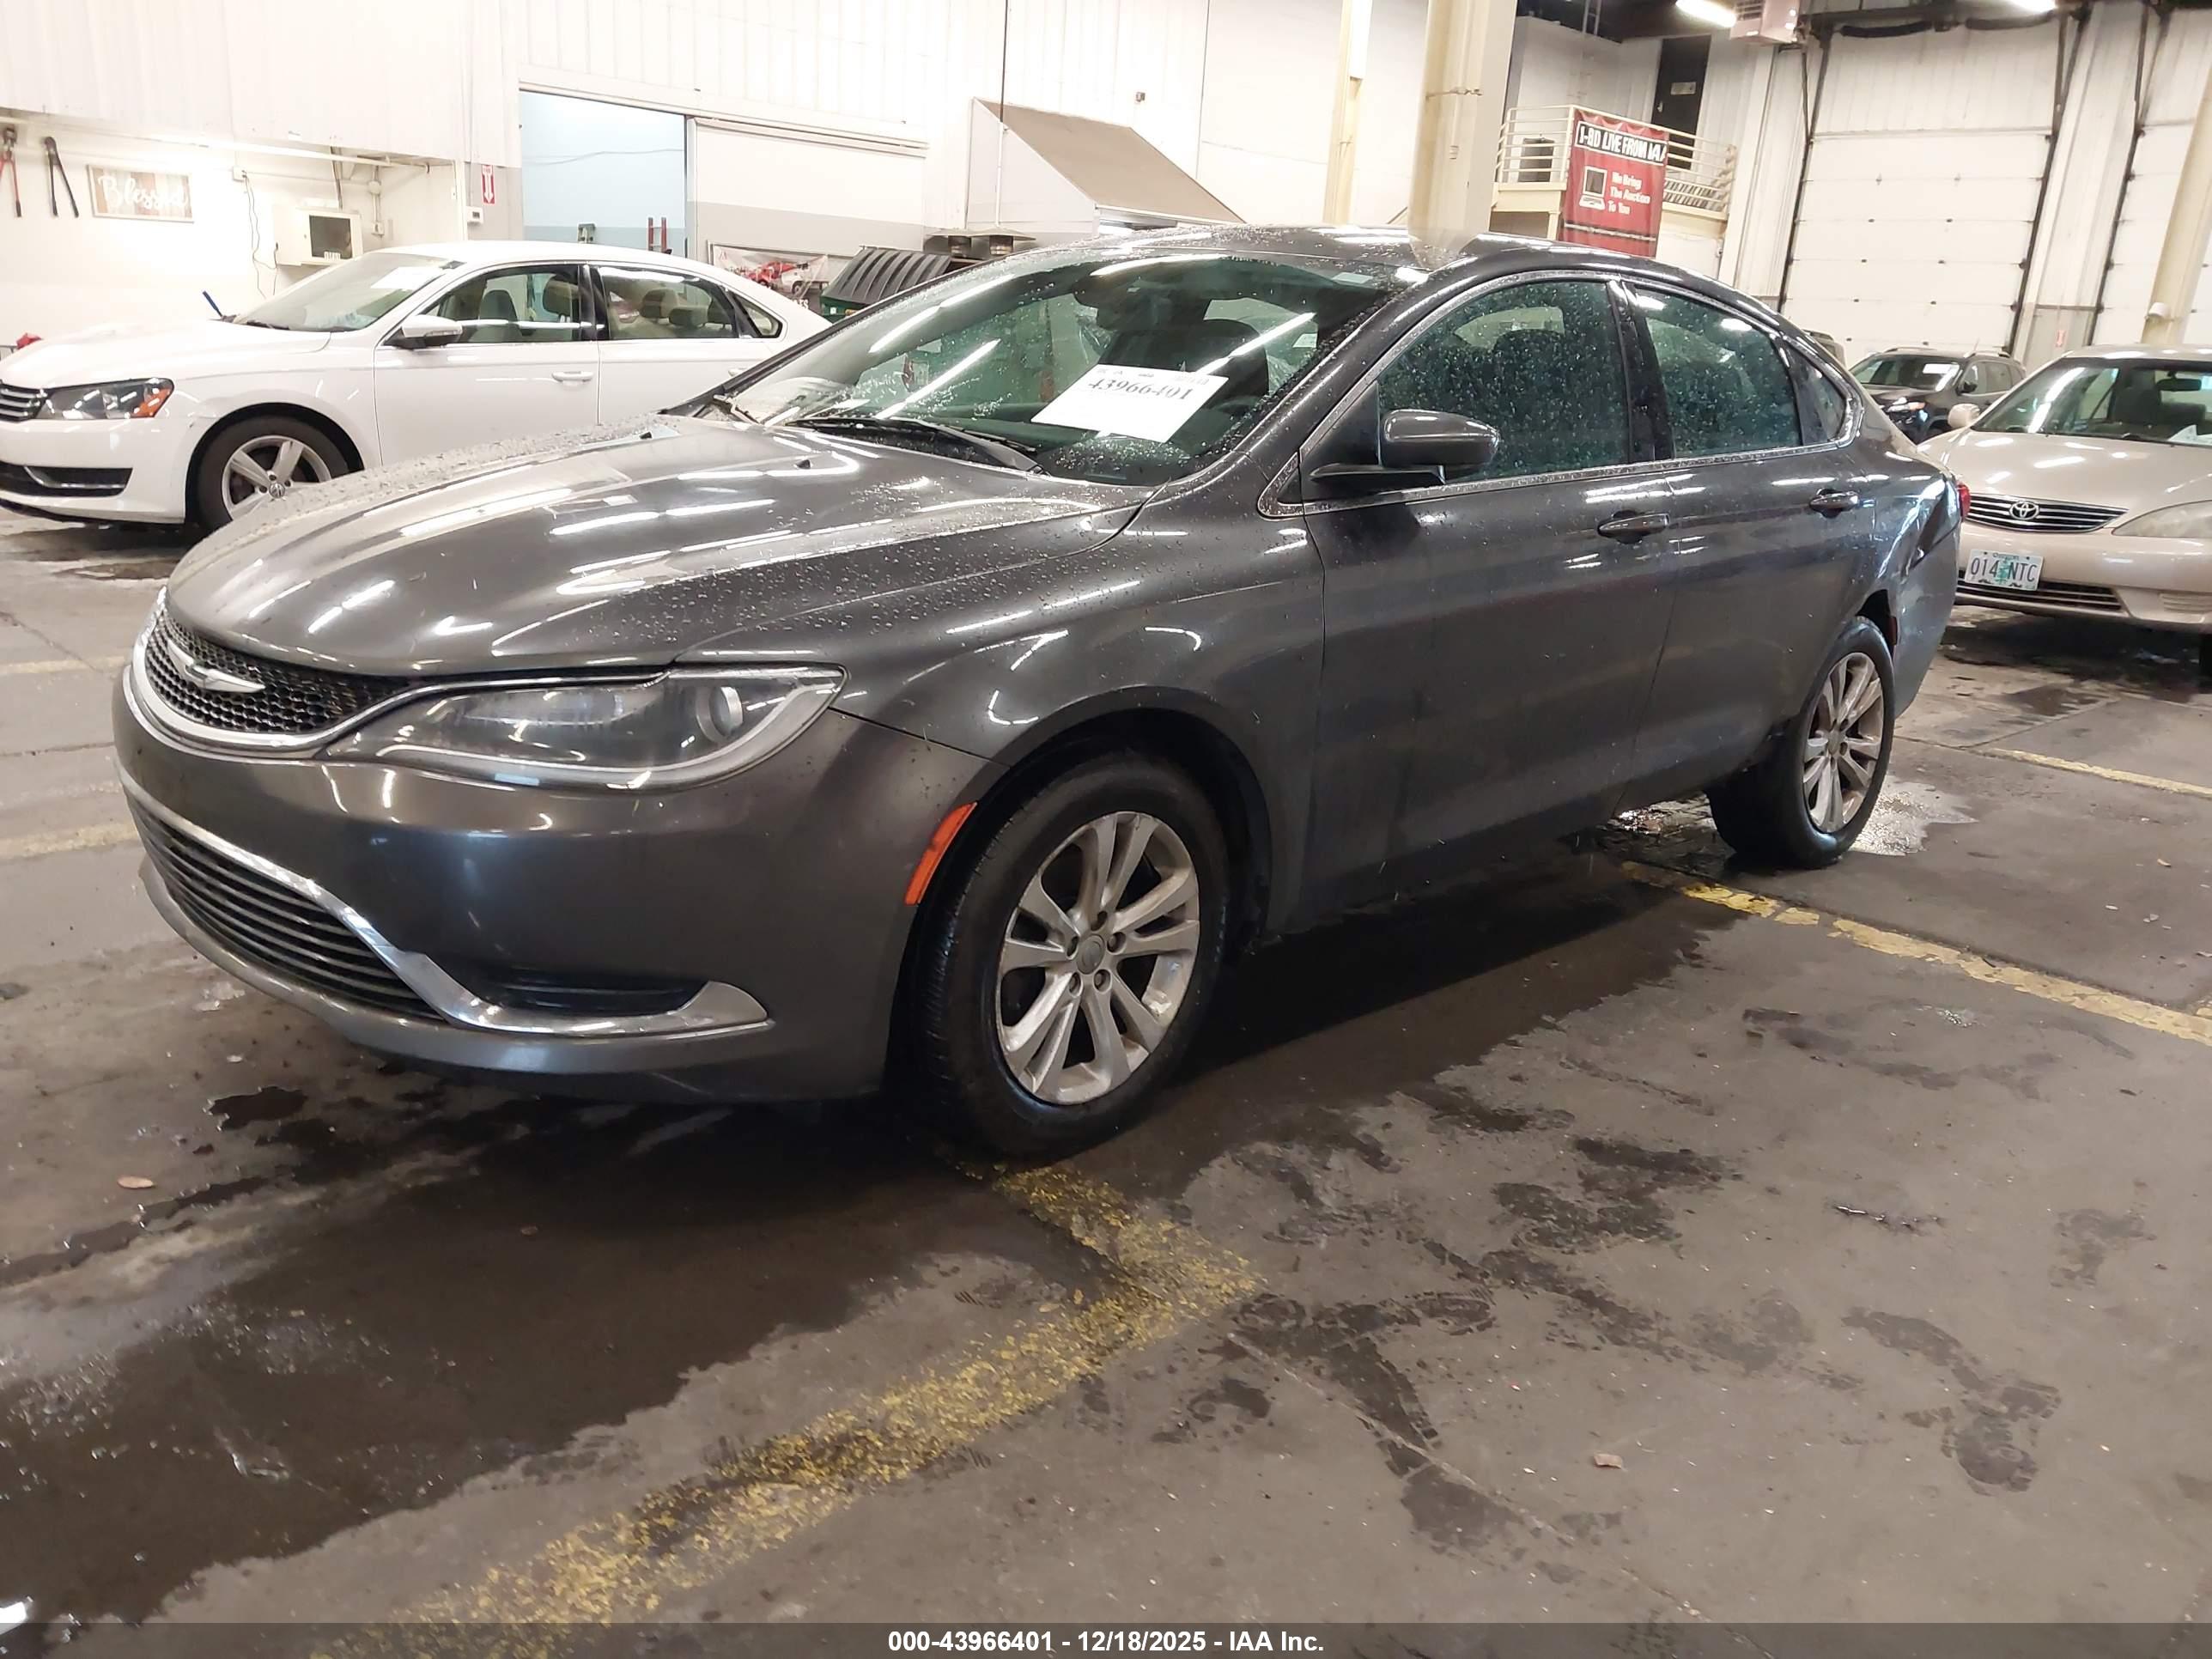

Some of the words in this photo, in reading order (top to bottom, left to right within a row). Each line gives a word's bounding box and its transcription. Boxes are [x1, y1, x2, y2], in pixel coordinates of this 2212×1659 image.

[1601, 131, 1622, 153] LIVE
[1622, 137, 1648, 159] FROM
[1607, 200, 1616, 212] To
[1088, 378, 1194, 400] 43966401
[1971, 557, 2000, 578] 014
[2008, 562, 2038, 582] NTC
